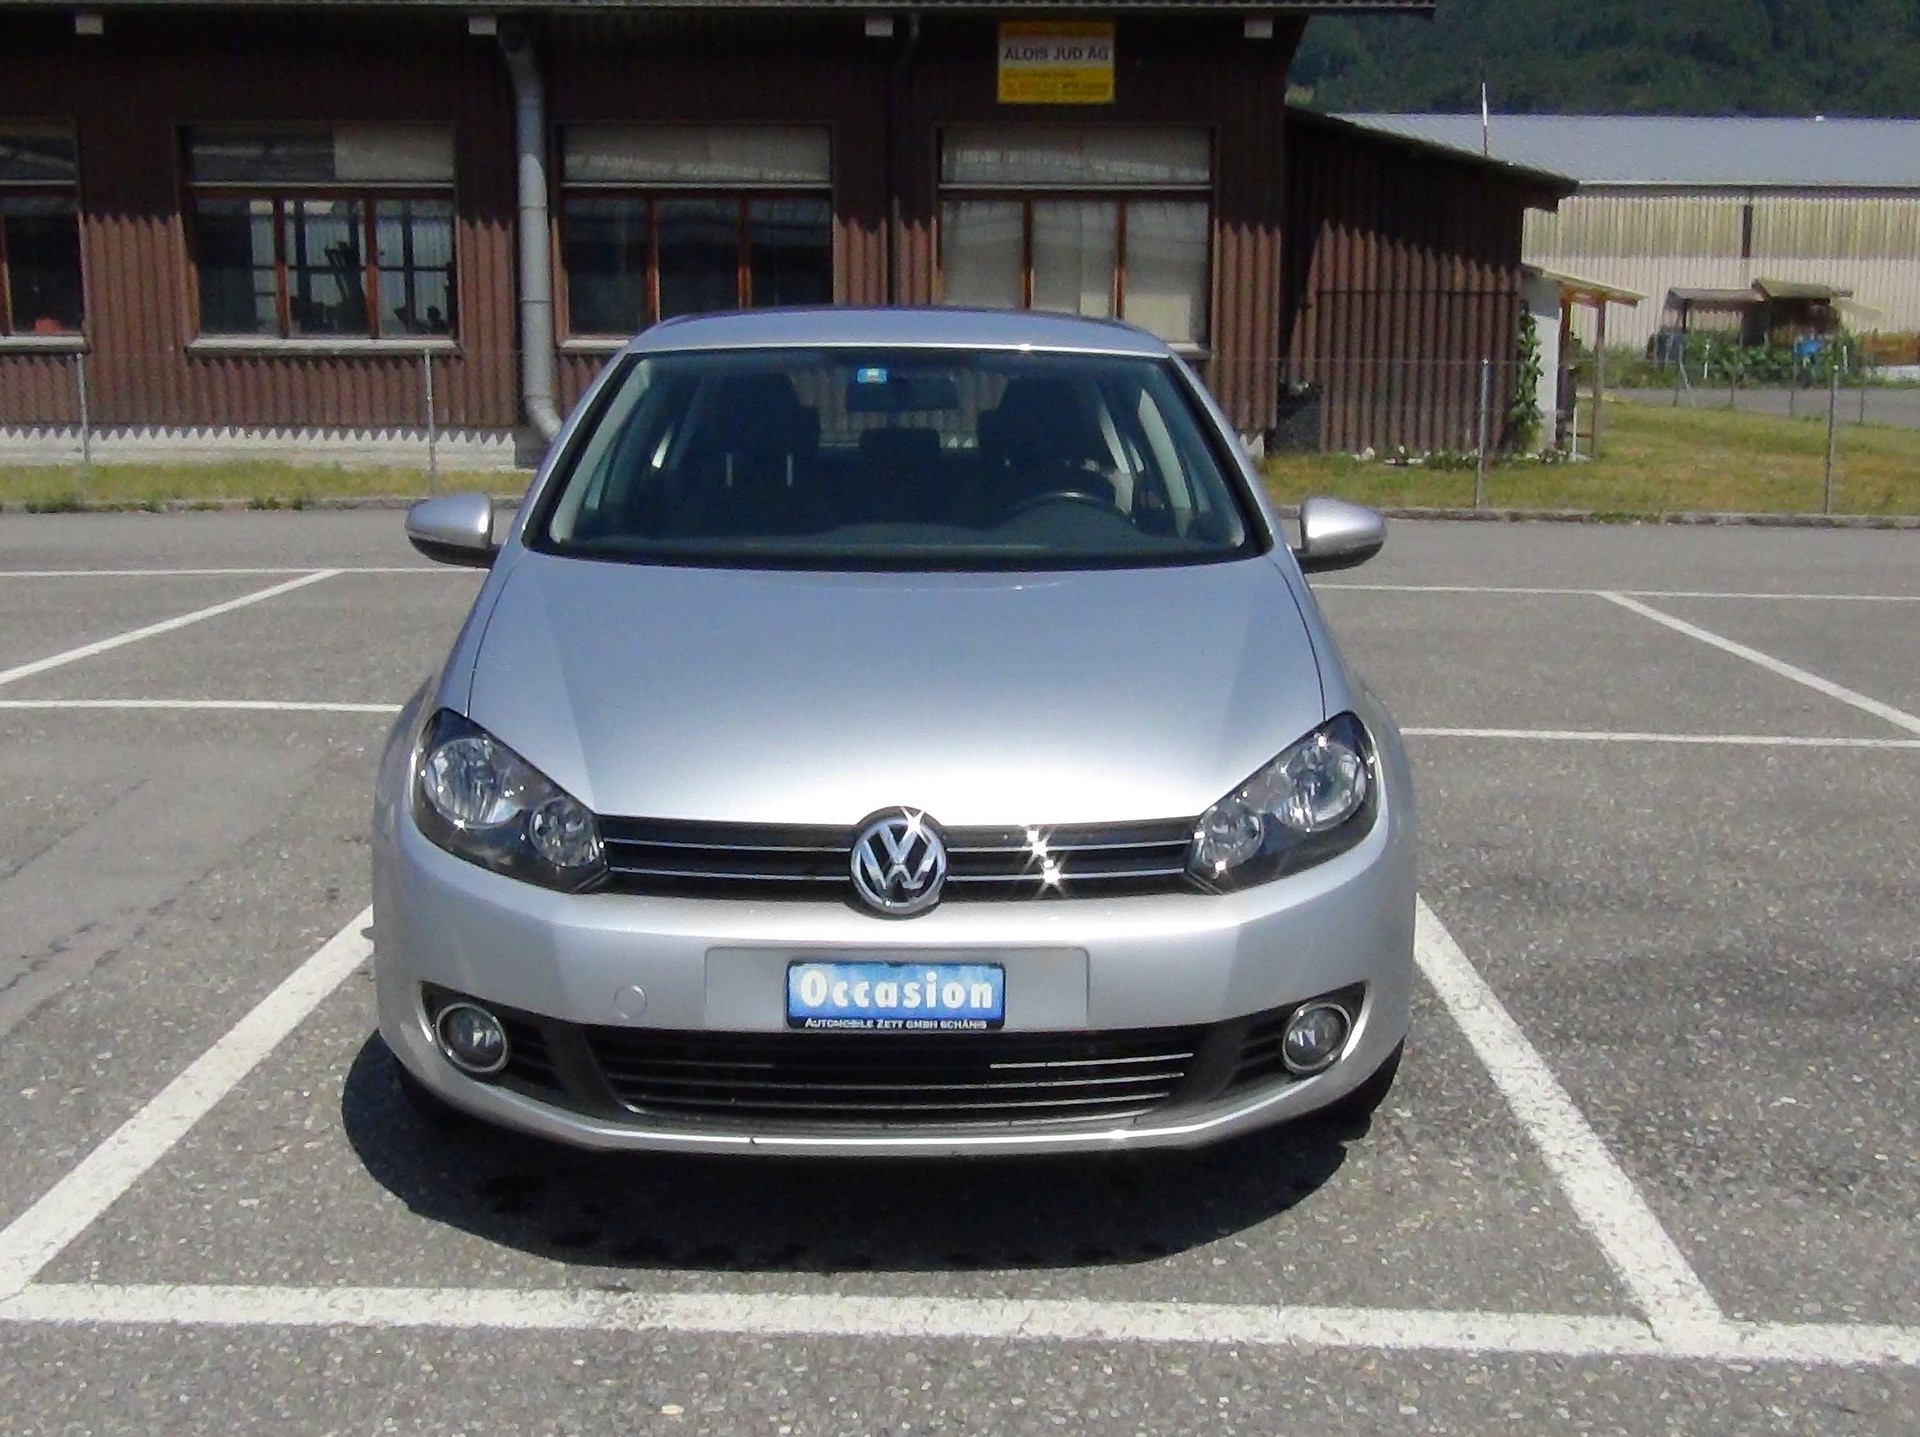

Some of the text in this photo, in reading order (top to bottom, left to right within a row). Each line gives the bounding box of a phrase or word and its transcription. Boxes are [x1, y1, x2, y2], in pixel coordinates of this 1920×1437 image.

[1005, 47, 1109, 61] ALOIS JUD AG
[852, 817, 946, 914] VW
[801, 970, 993, 1009] Occasion
